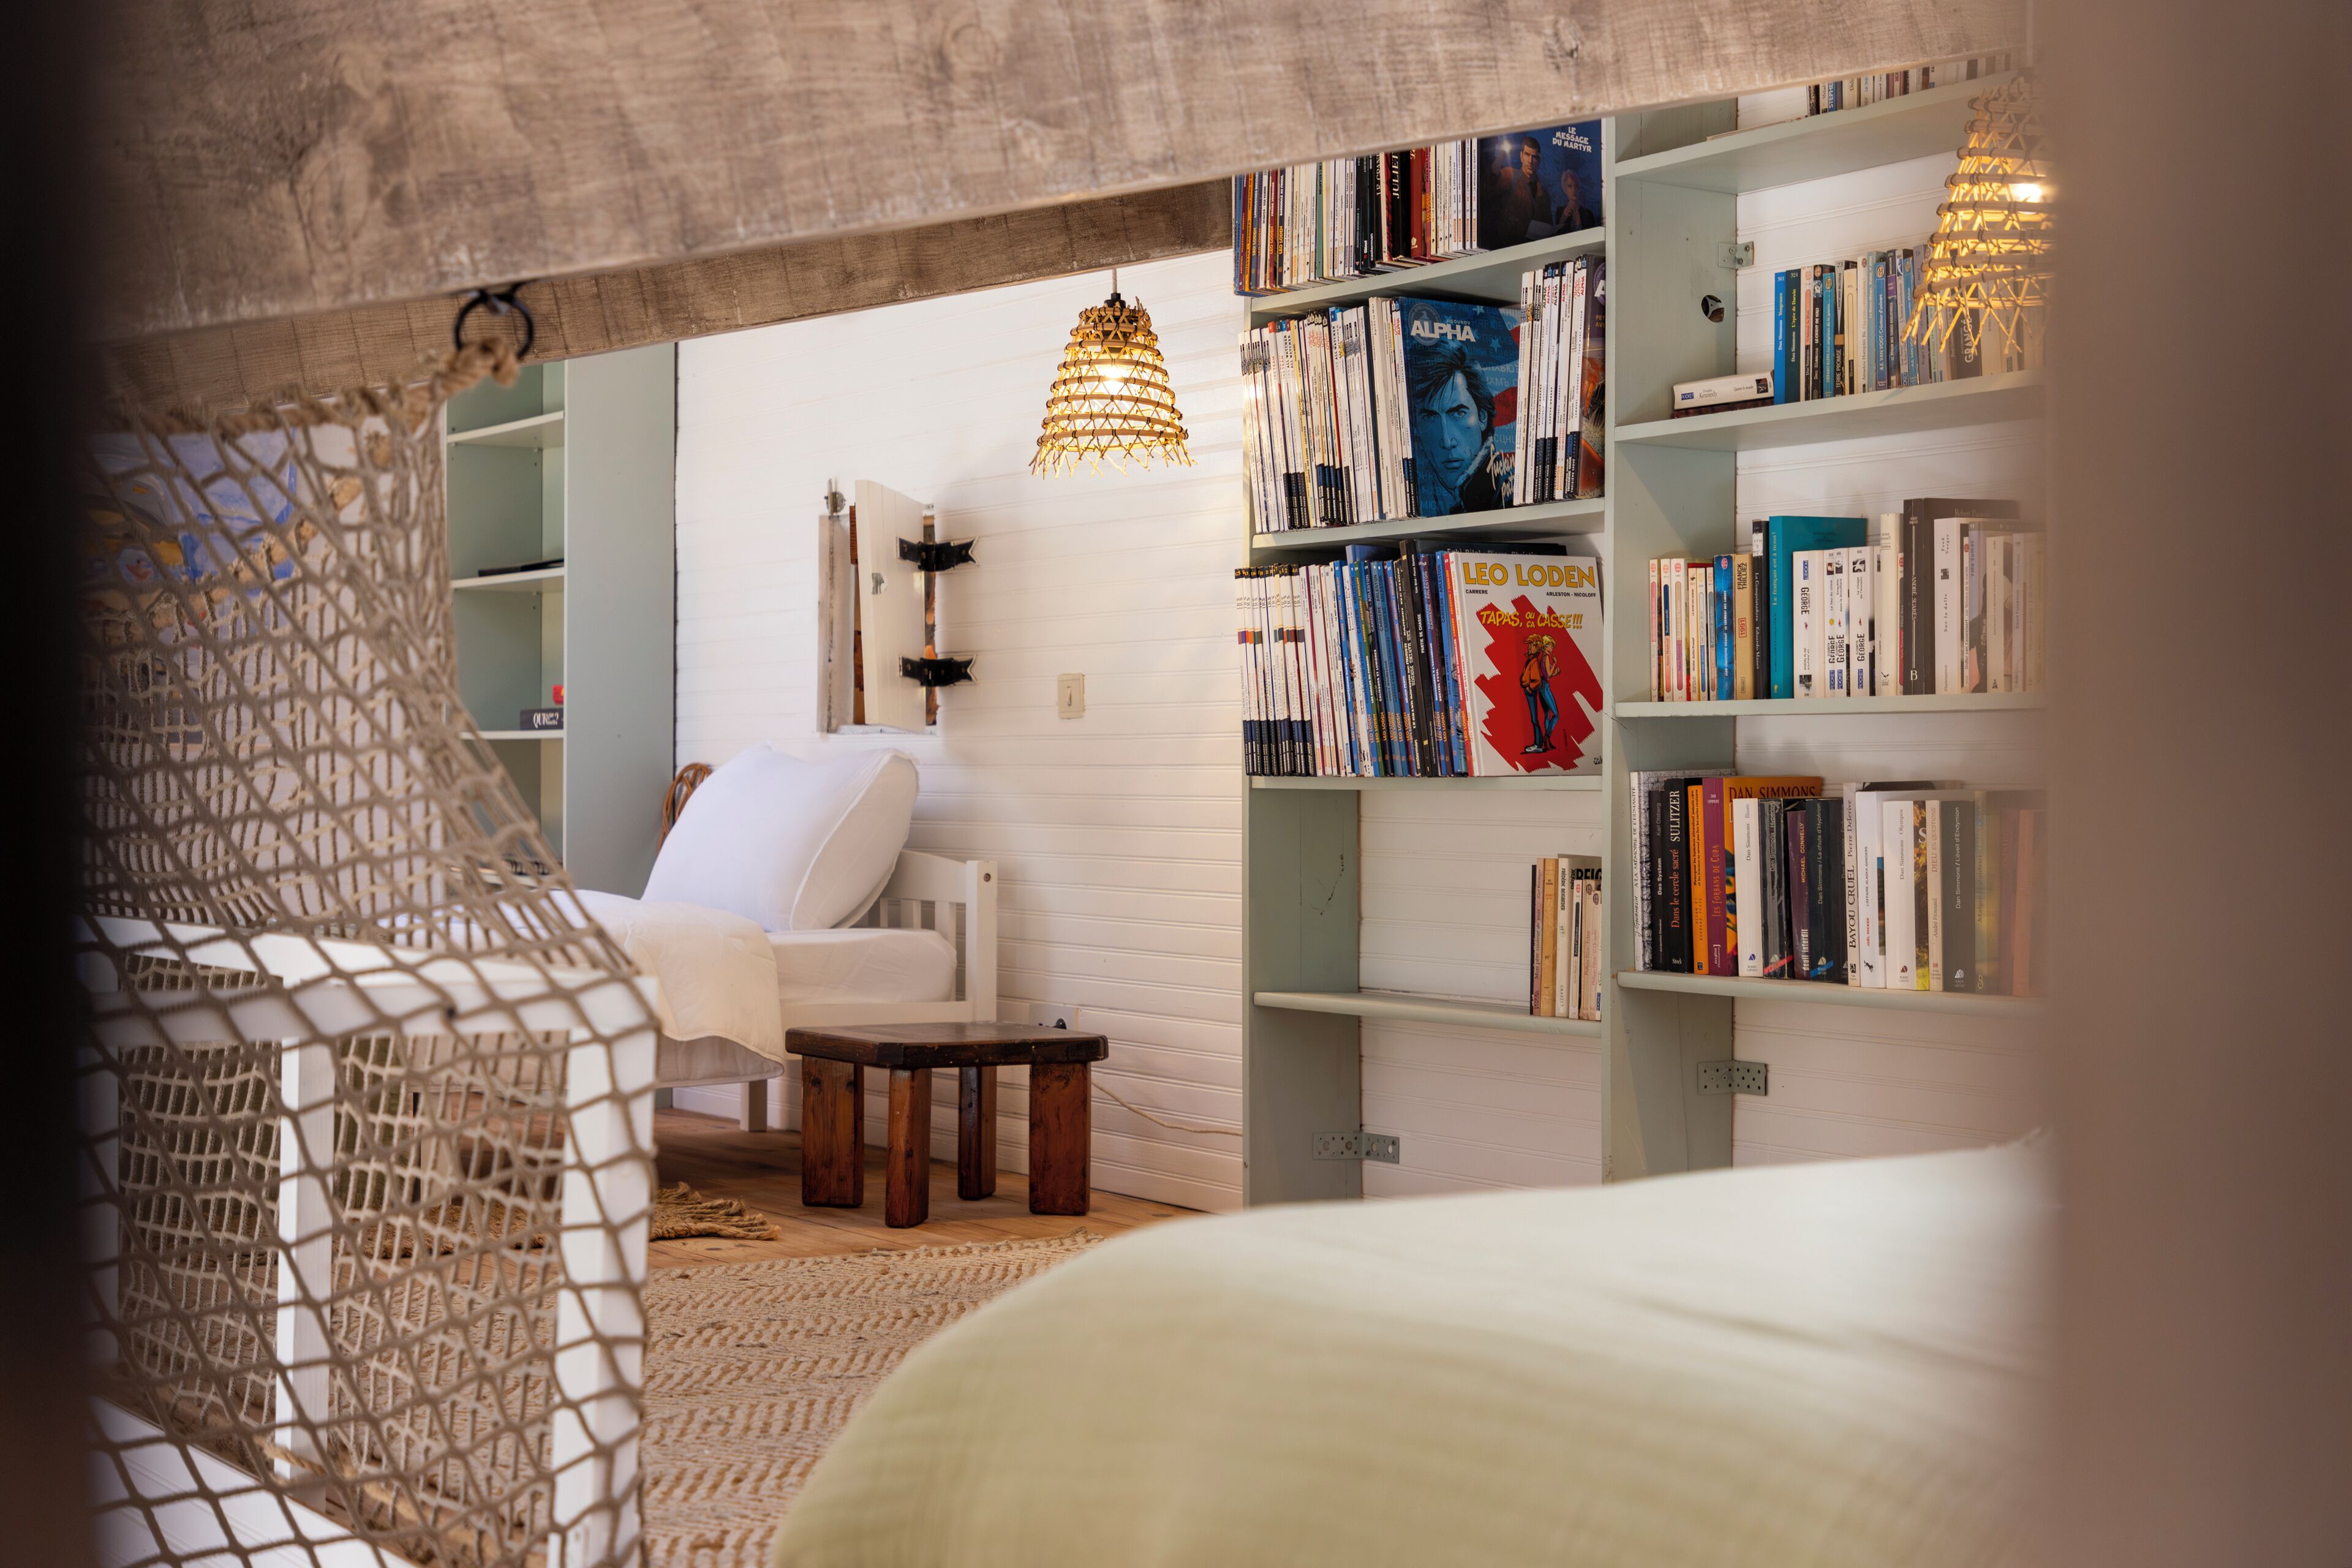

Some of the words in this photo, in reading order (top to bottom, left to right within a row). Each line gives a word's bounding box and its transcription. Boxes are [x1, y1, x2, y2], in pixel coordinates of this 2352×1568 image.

[1556, 131, 1589, 145] MESSAGE
[1568, 126, 1577, 135] LE
[1552, 137, 1562, 146] DU
[1563, 141, 1592, 153] MARTYR
[1411, 320, 1476, 343] ALPHA
[1961, 316, 1973, 363] GRANGÉ
[1463, 562, 1509, 586] LEO
[1515, 564, 1596, 588] LODEN
[1773, 597, 1777, 605] Le
[1480, 611, 1523, 627] TAPAS,
[1537, 613, 1583, 629] CASSE!!!
[1729, 787, 1752, 798] DAN
[1759, 786, 1815, 797] SIMMONS
[1670, 791, 1681, 842] SULITZER
[1670, 850, 1679, 869] sacré
[1711, 845, 1720, 862] CUBA
[1670, 872, 1679, 896] cercle
[1711, 876, 1722, 903] FORBANS
[1671, 908, 1680, 928] Dans
[1713, 907, 1721, 916] LES
